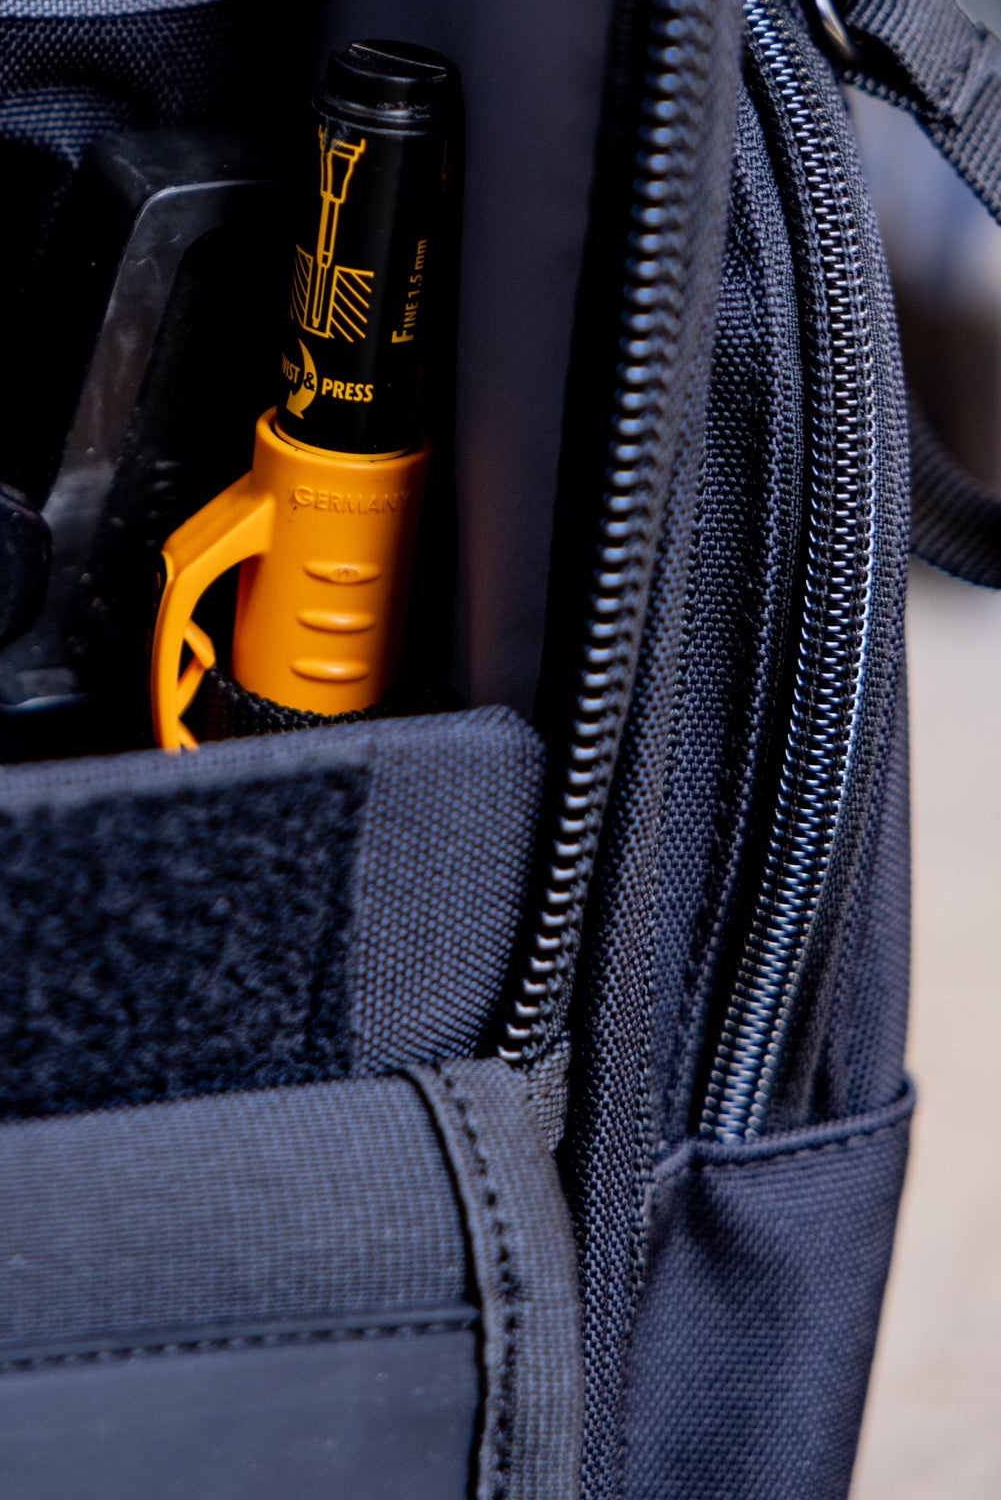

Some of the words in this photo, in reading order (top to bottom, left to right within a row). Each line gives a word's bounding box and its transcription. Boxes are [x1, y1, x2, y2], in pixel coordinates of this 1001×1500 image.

[414, 239, 428, 270] mm
[408, 273, 422, 299] 1.5
[391, 301, 419, 344] FINE
[321, 377, 375, 403] PRESS
[293, 485, 409, 514] GERMANY
